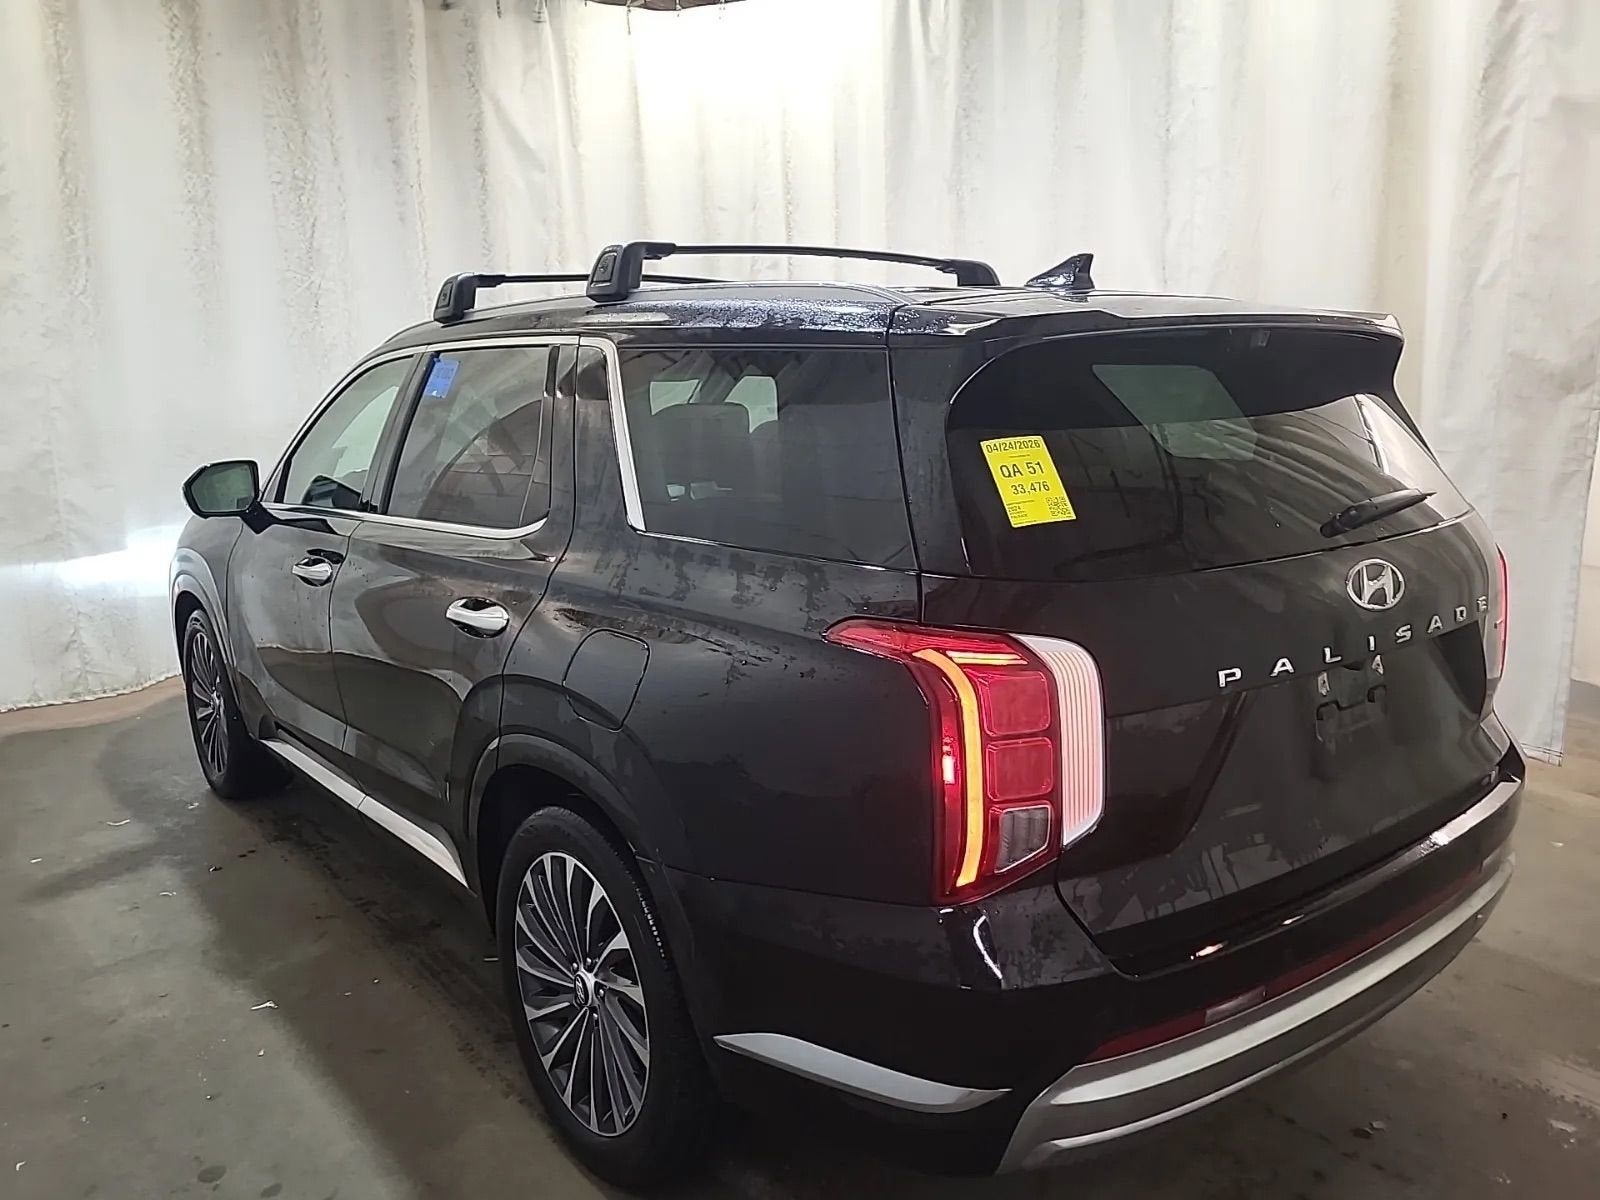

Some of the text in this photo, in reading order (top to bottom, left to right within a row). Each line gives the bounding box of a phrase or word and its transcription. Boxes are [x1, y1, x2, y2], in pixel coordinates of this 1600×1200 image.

[985, 439, 1040, 453] 04/24/2026
[999, 461, 1045, 478] QA 51
[1010, 481, 1050, 495] 33,476
[1217, 595, 1489, 688] PALISADE
